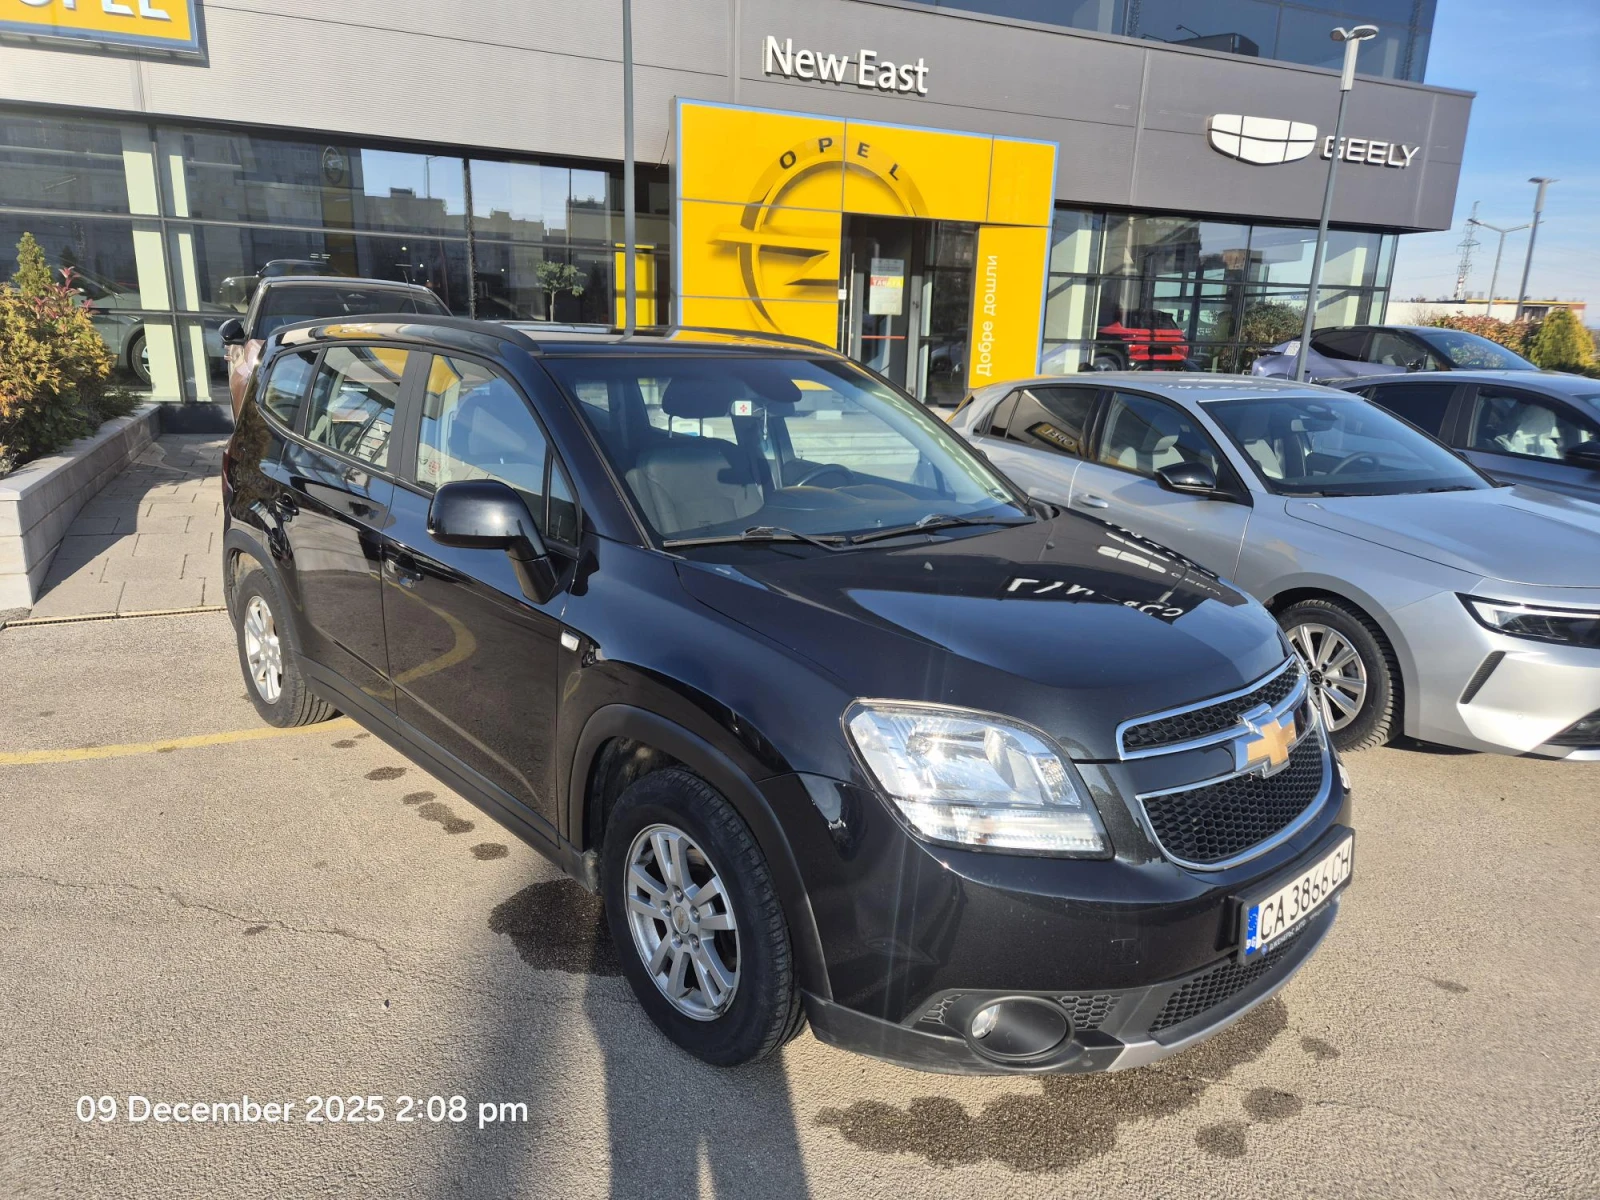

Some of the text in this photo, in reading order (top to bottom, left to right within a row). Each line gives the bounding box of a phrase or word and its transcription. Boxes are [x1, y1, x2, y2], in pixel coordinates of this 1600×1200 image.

[765, 35, 930, 95] New East
[779, 136, 899, 181] OPEL
[1323, 135, 1421, 168] GEELY
[976, 255, 998, 377] Добре дошли
[1261, 895, 1285, 940] CA
[1290, 861, 1328, 921] 3866
[1332, 843, 1351, 886] CH
